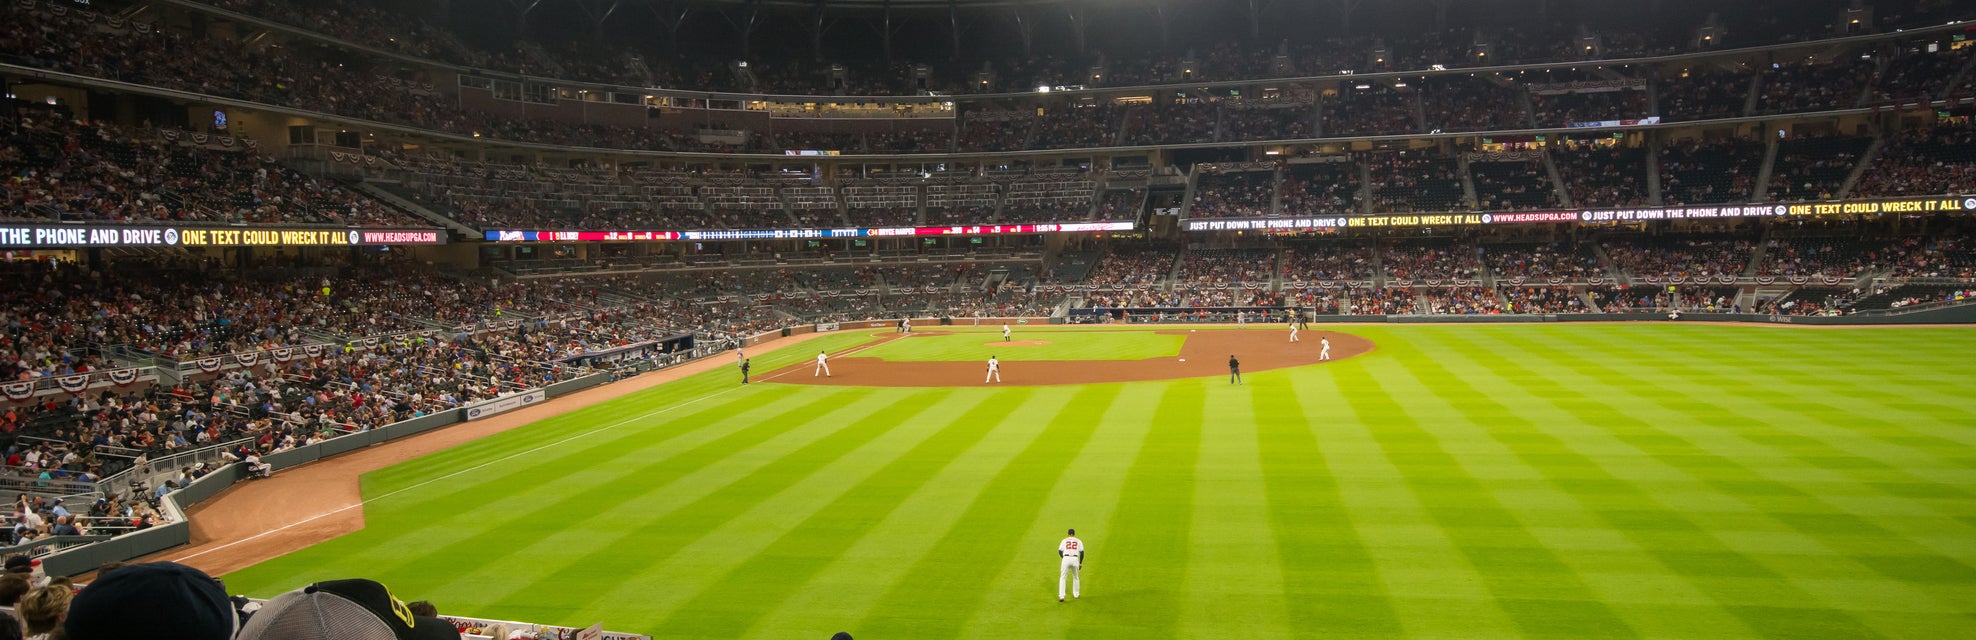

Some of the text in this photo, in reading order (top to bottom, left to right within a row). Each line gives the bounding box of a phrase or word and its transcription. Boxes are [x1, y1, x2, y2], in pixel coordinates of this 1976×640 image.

[1593, 206, 1773, 220] JUST PUT DOWN THE PHONE AND DRIVE
[1789, 200, 1961, 215] ONE TEXT COULD WRECK IT ALL
[1348, 214, 1481, 227] ONE TEXT COULD WRECK IT ALL
[1493, 212, 1577, 222] WWW.HEADSUPGA.COM
[1189, 219, 1336, 230] JUST PUT DOWN THE PHONE AND DRIVE
[0, 228, 161, 244] THE PHONE AND DRIVE
[182, 229, 347, 245] ONE TEXT COULD WRECK IT ALL
[364, 232, 437, 243] WWW.HEADSUPGA.COM
[1066, 541, 1078, 549] 22
